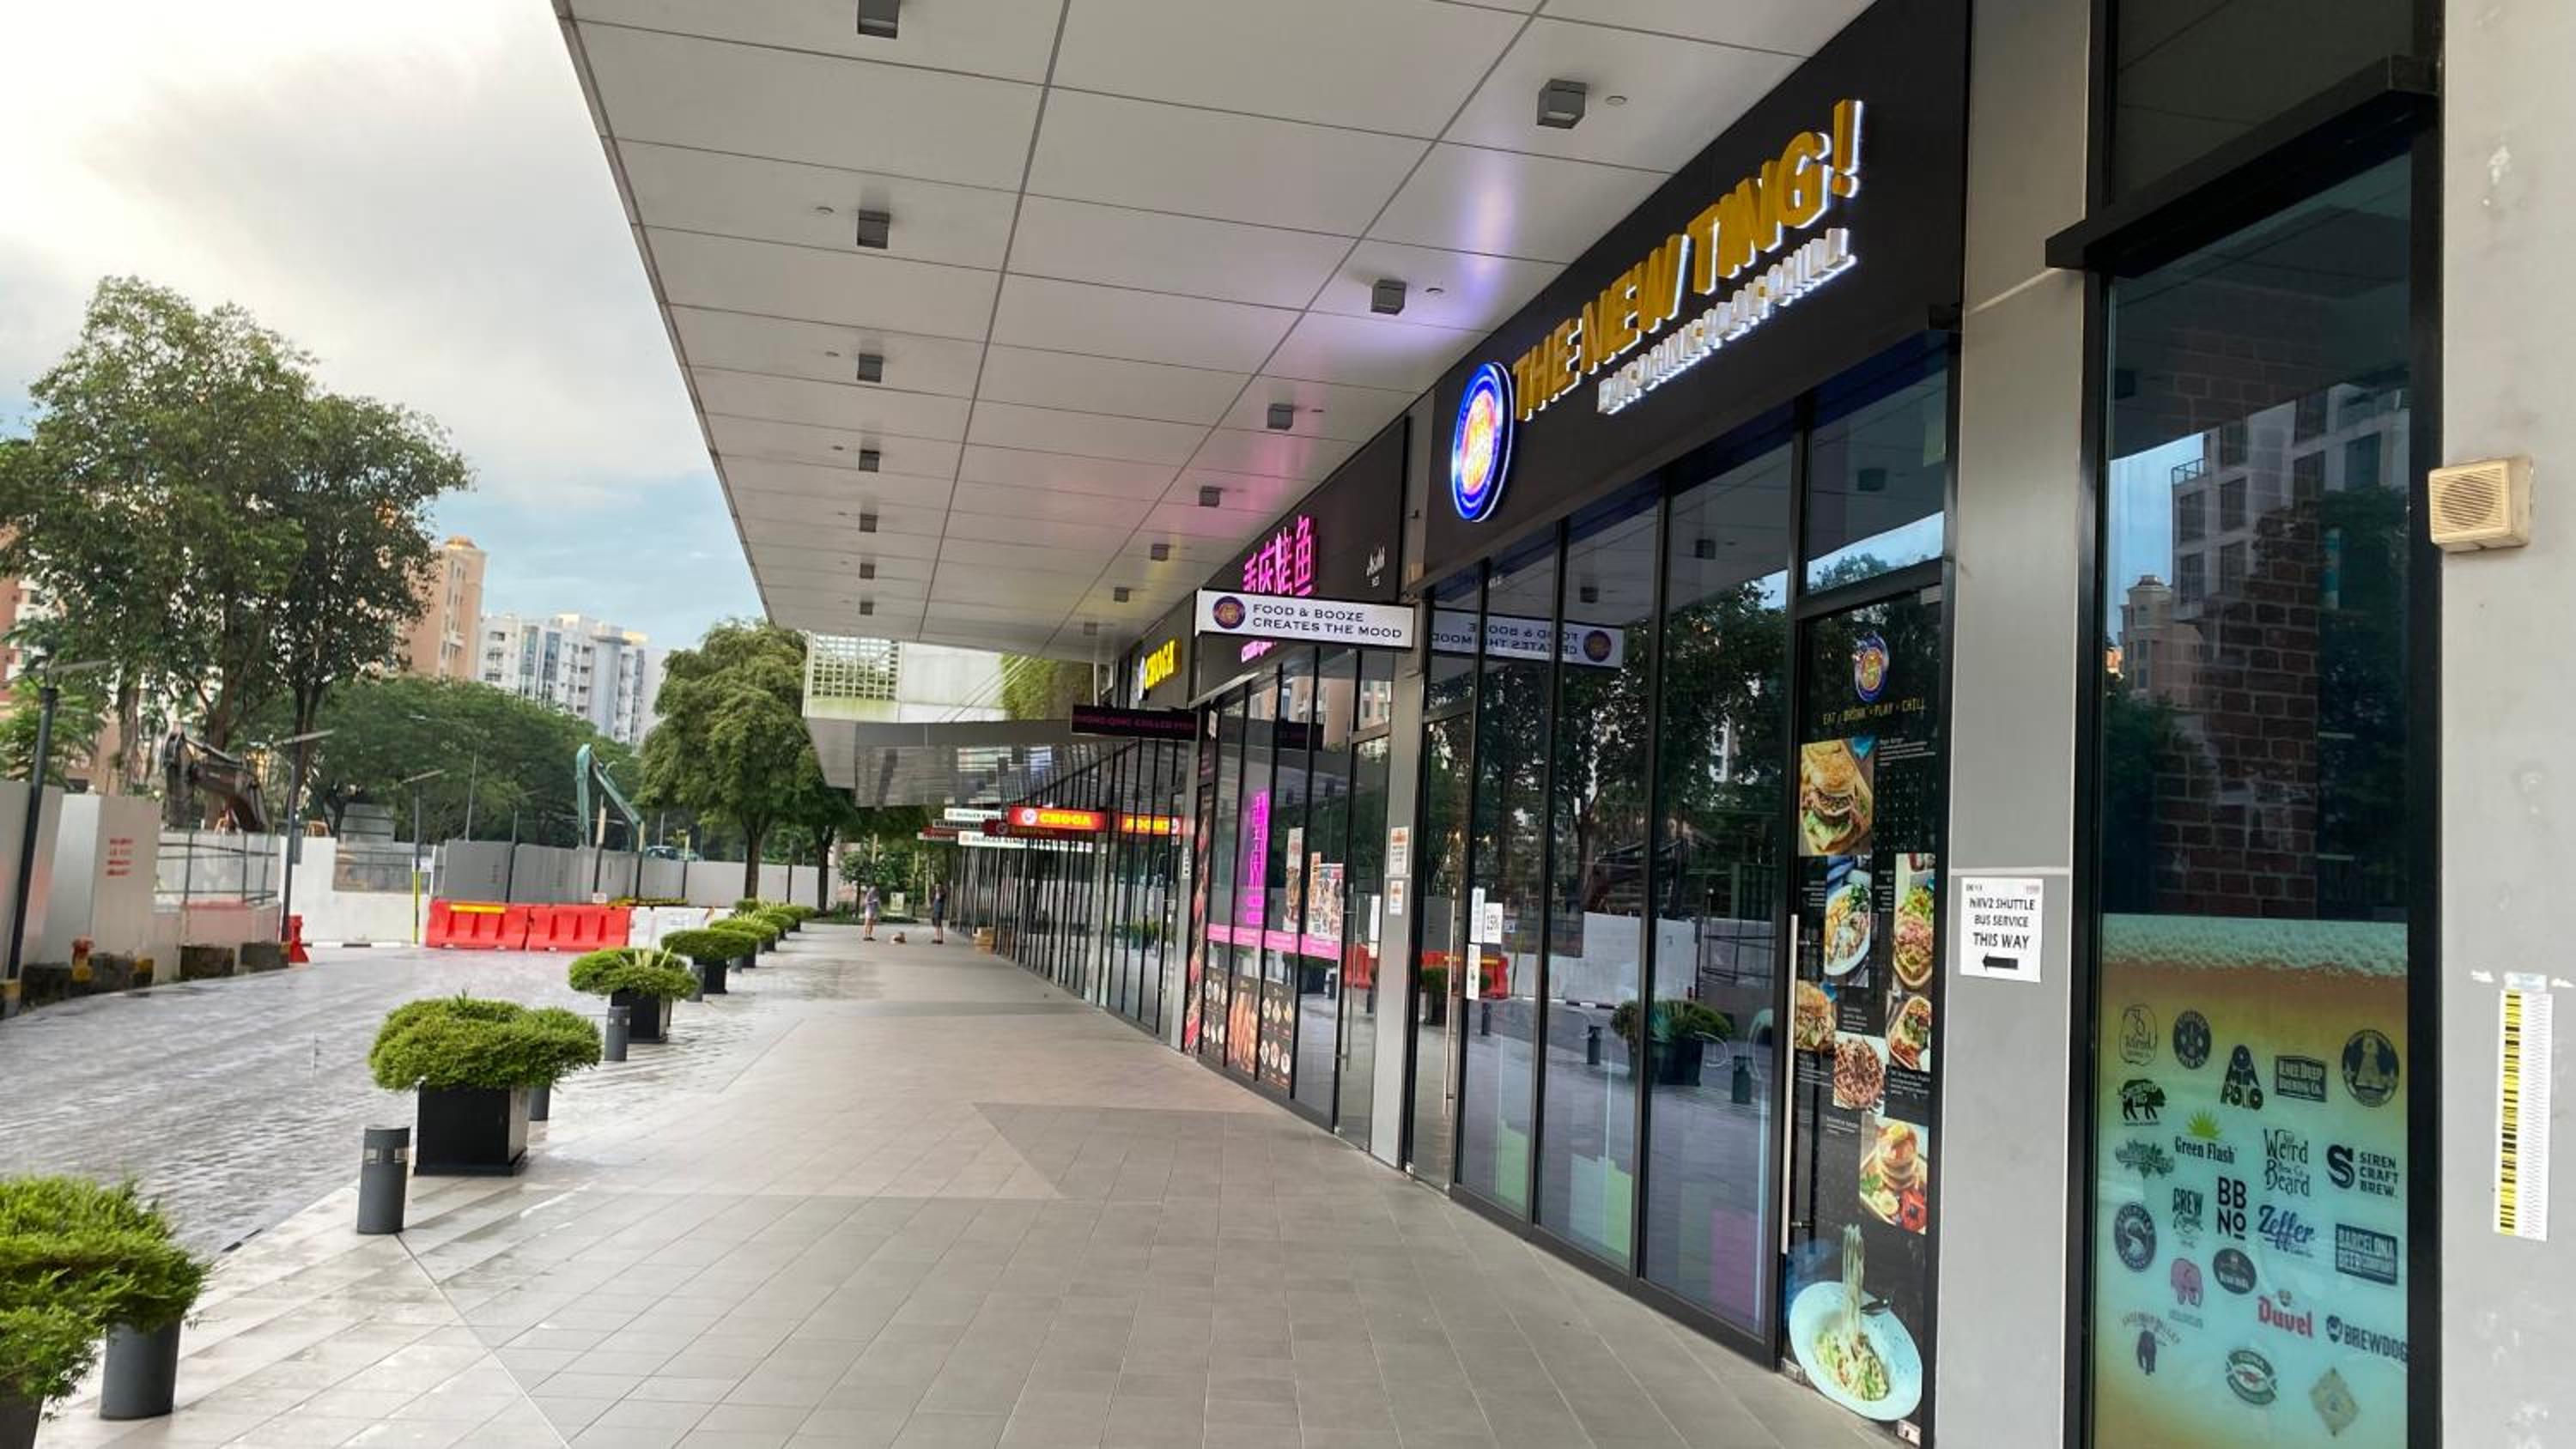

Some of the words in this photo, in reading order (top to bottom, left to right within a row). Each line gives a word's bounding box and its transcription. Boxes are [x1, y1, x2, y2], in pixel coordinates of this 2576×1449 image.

[1512, 317, 1583, 421] THE
[1579, 233, 1690, 375] NEW
[1687, 100, 1863, 295] TING!
[1253, 603, 1294, 616] FOOD
[1299, 608, 1309, 617] &
[1315, 609, 1364, 622] BOOZE
[1253, 617, 1321, 633] CREATES
[1325, 623, 1353, 634] THE
[1358, 627, 1402, 639] MOOD
[1040, 810, 1092, 826] CHOGA
[1996, 899, 2035, 911] SHUTTLE
[1974, 915, 1990, 925] BUS
[1993, 915, 2029, 927] SERVICE
[1973, 932, 1998, 947] THIS
[2002, 934, 2030, 949] WAY
[2175, 1136, 2204, 1158] Green
[2207, 1143, 2235, 1164] Flash
[2263, 1129, 2309, 1164] Weird
[2360, 1151, 2397, 1168] SIREN
[2265, 1159, 2311, 1197] Beard
[2360, 1166, 2398, 1184] CRAFT
[2218, 1176, 2247, 1210] BB
[2258, 1204, 2315, 1252] Zeffer
[2257, 1294, 2314, 1338] Duvel
